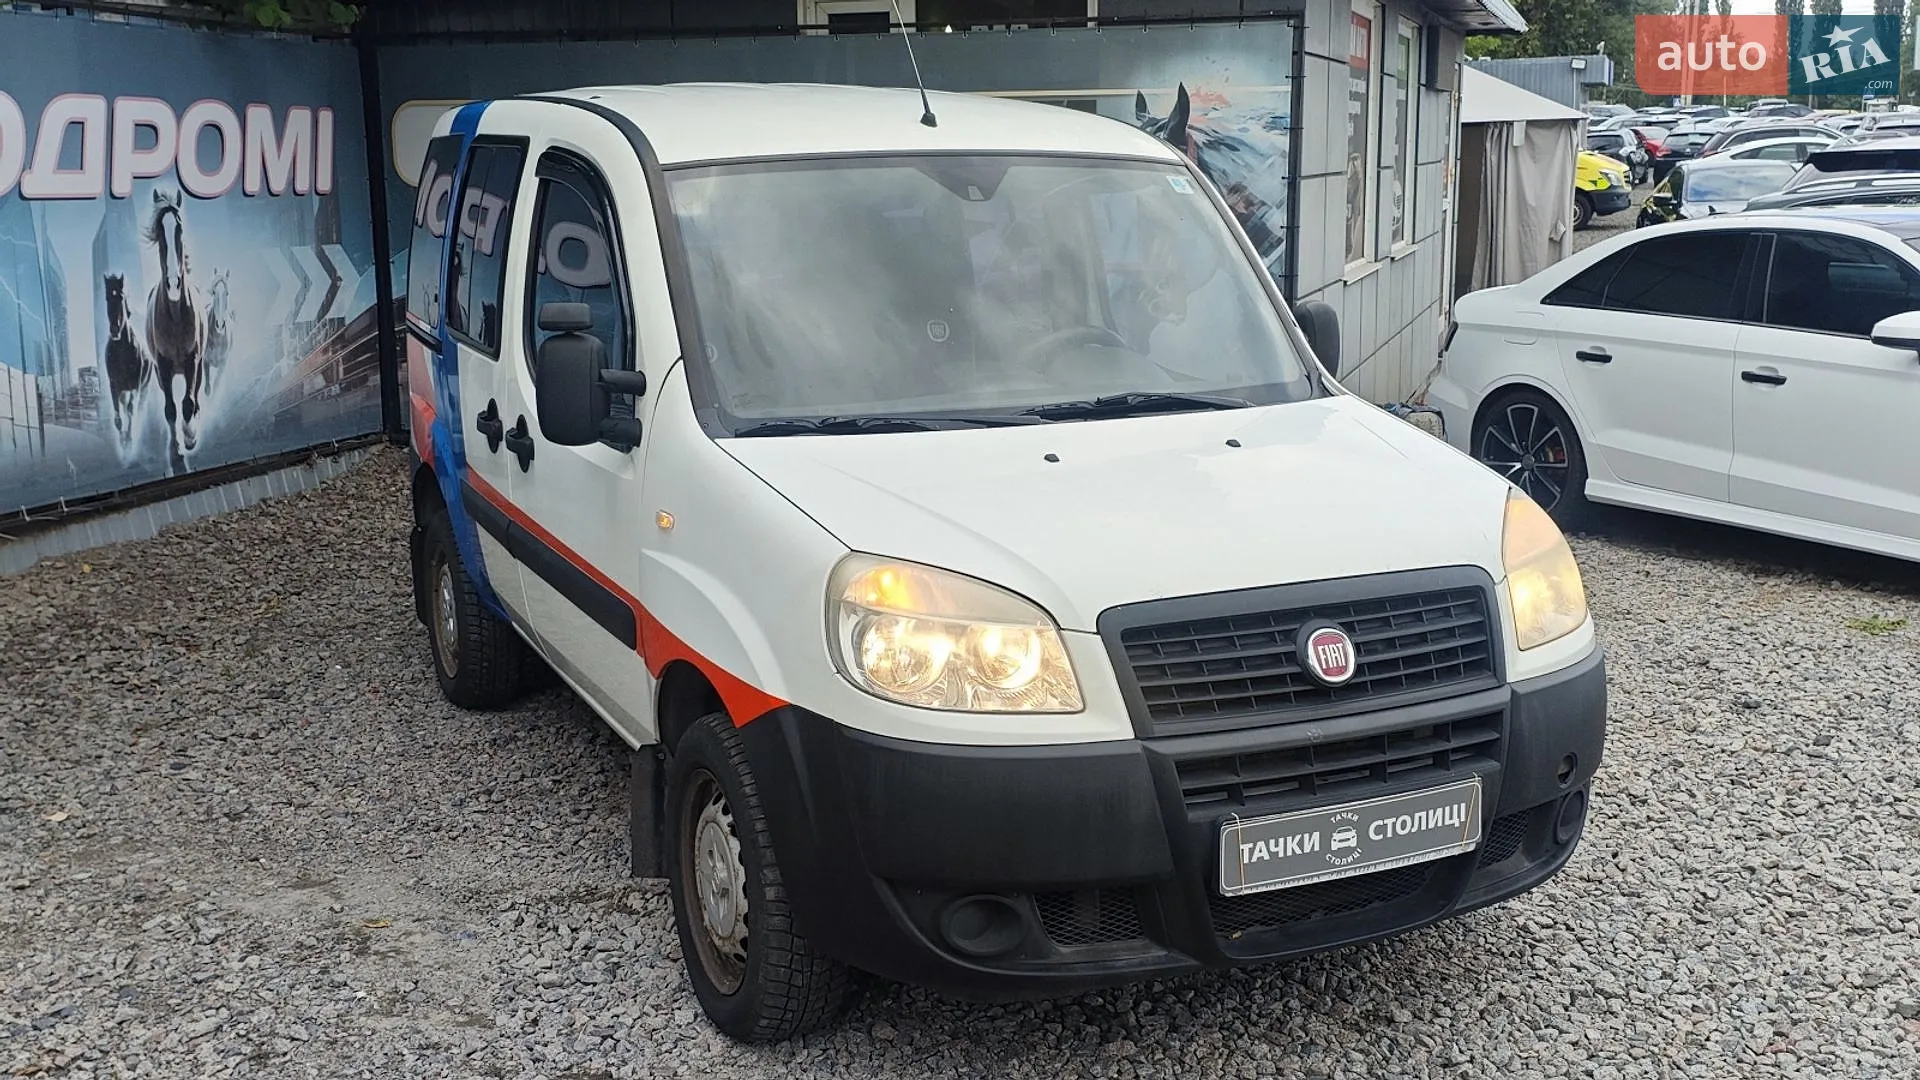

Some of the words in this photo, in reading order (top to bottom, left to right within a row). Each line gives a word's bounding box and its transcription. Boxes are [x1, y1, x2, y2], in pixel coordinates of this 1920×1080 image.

[1317, 642, 1348, 669] FIAT
[1330, 811, 1360, 824] ТАЧКИ
[1240, 831, 1320, 864] ТАЧКИ
[1368, 802, 1467, 841] СТОЛИЦІ
[1325, 848, 1363, 866] СТОЛИЦІ
